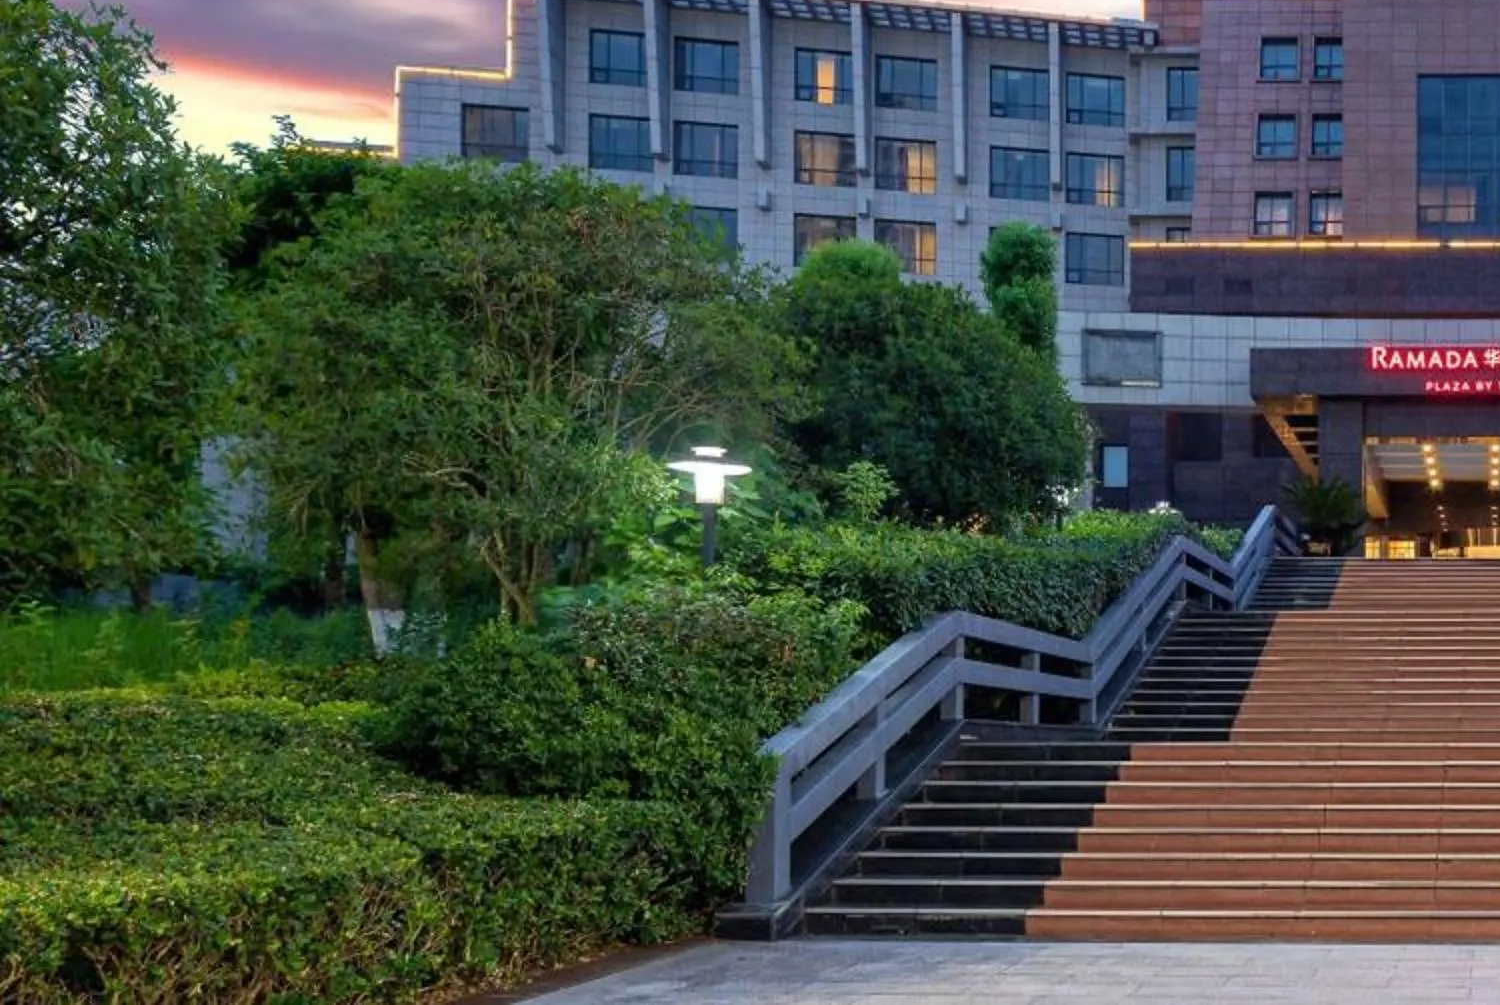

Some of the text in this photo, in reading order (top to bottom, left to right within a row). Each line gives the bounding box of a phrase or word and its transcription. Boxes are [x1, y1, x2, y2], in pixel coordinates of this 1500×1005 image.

[1371, 346, 1479, 369] RAMADA
[1425, 381, 1470, 391] PLAZA
[1475, 381, 1493, 391] BY
